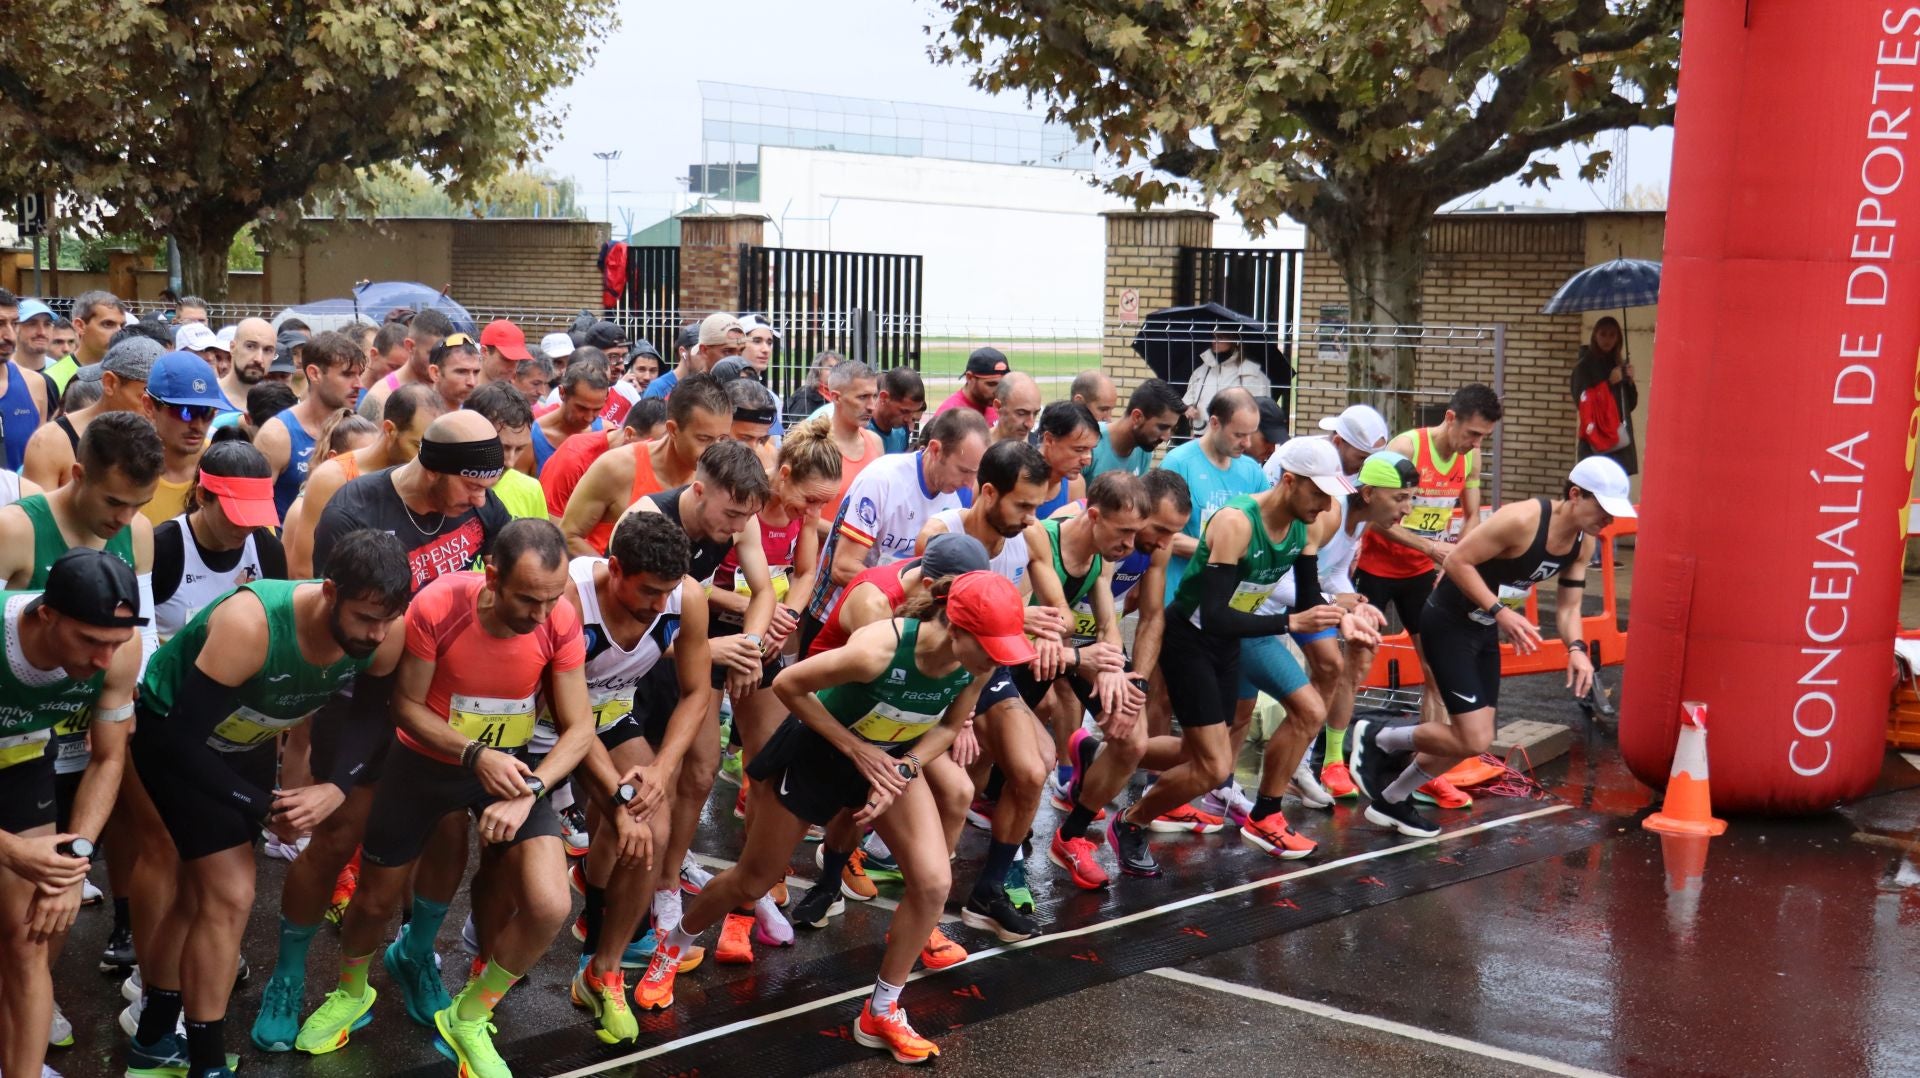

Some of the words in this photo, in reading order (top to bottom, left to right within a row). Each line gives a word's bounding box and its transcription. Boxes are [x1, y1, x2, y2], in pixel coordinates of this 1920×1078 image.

[1845, 7, 1920, 305] DEPORTES
[1832, 333, 1882, 405] DE
[1419, 512, 1440, 531] 32
[409, 533, 471, 576] ESPENSA
[416, 568, 431, 586] DE
[1789, 431, 1869, 776] CONCEJALÍA
[1075, 619, 1097, 636] 34
[478, 722, 506, 747] 41
